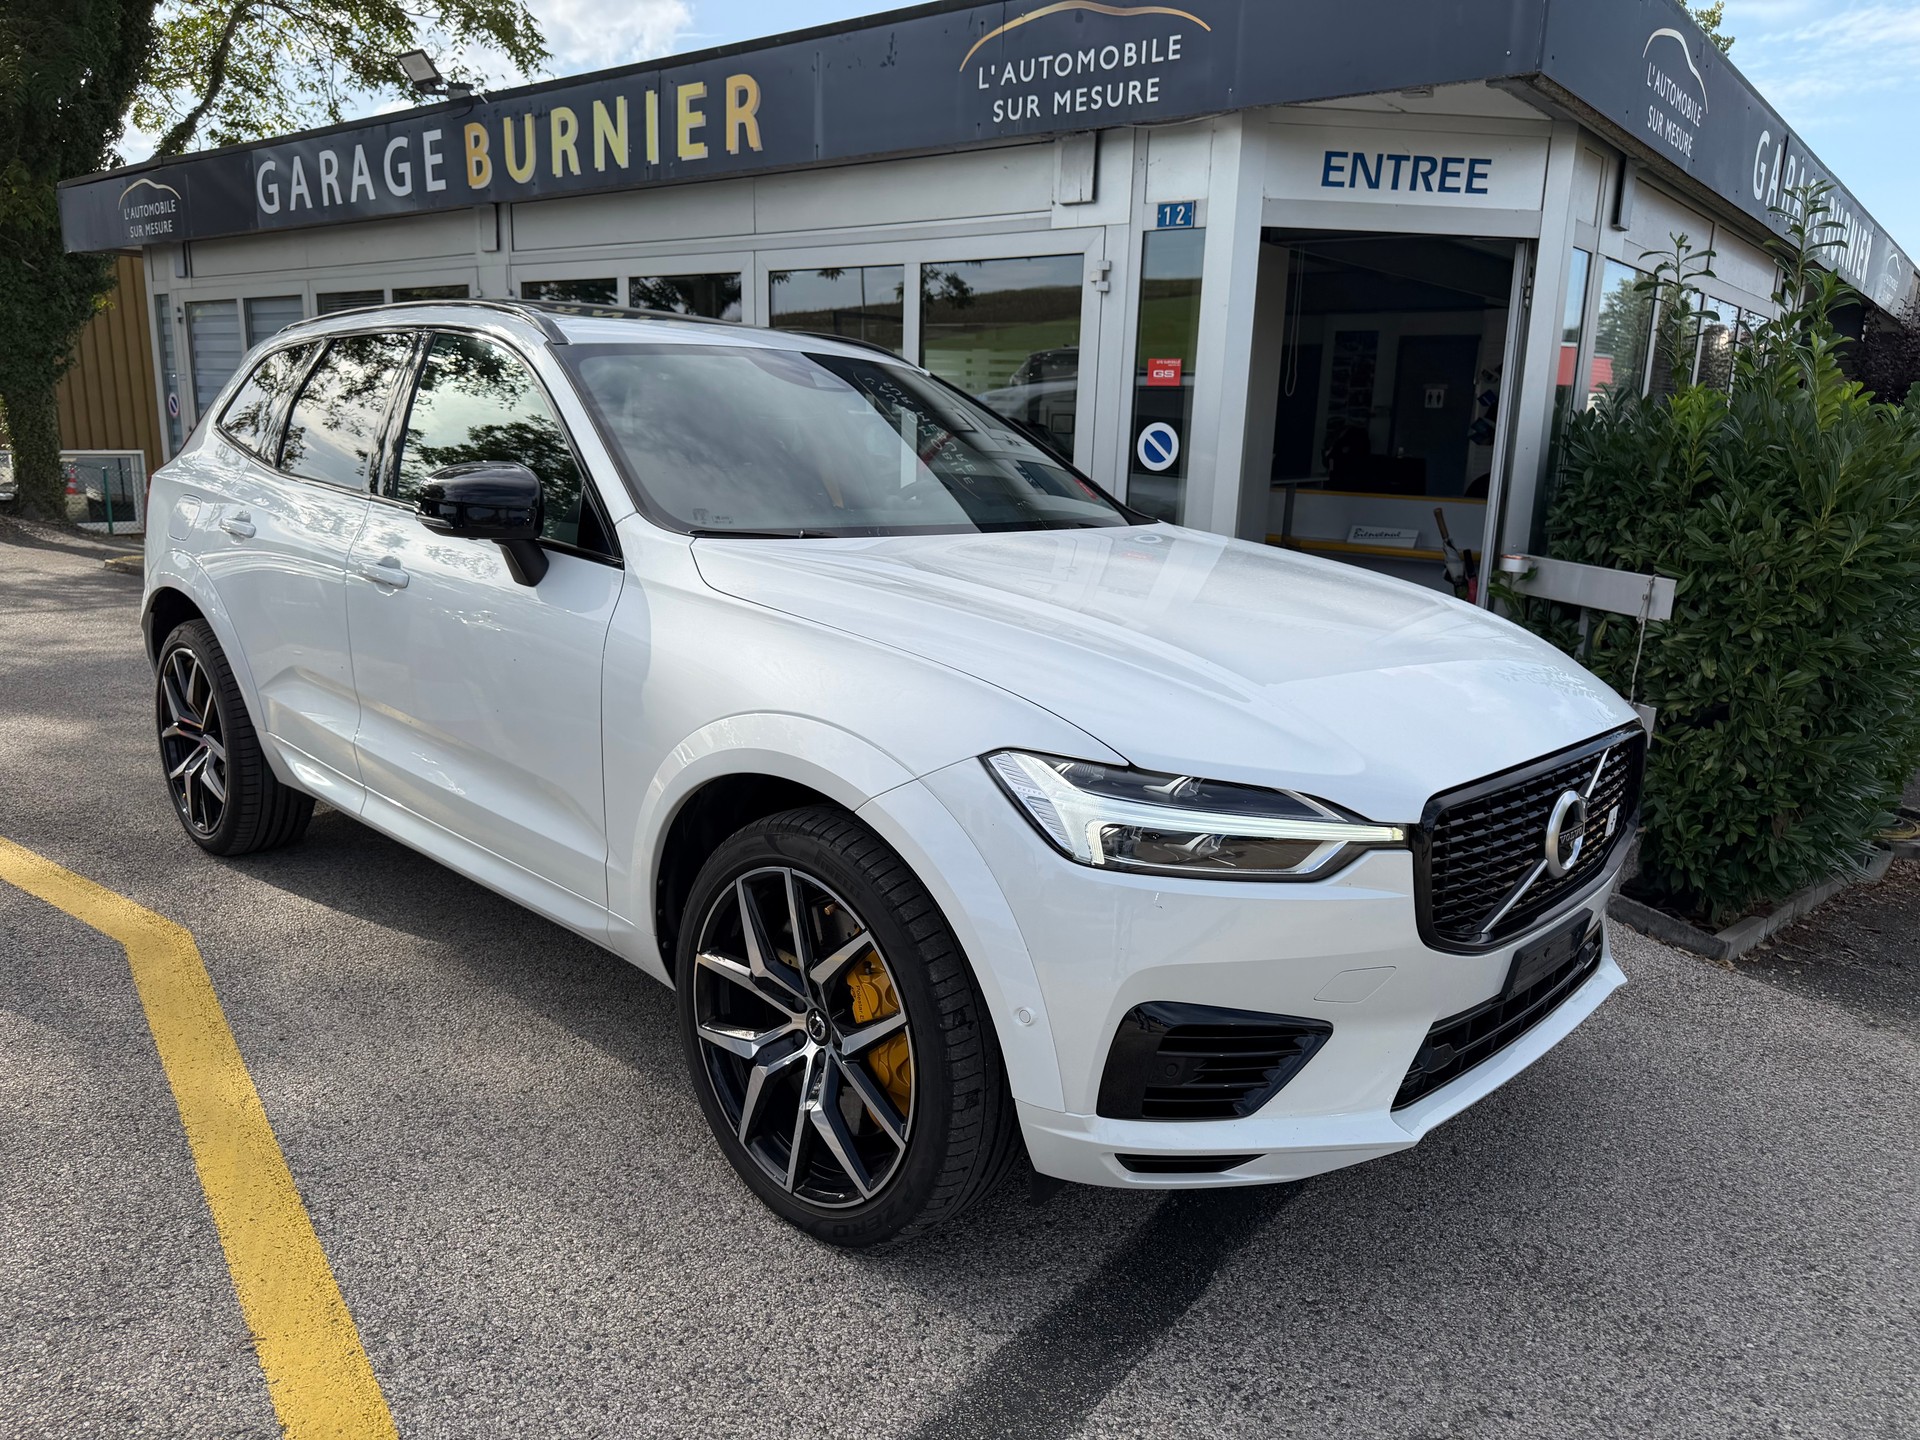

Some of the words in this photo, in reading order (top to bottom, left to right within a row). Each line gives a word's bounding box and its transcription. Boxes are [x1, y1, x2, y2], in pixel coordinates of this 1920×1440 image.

[978, 34, 1183, 90] L'AUTOMOBILE
[992, 94, 1041, 124] SUR
[1053, 77, 1160, 116] MESURE
[1646, 62, 1703, 128] L'AUTOMOBILE
[255, 128, 448, 215] GARAGE
[463, 73, 763, 190] BURNIER
[1647, 104, 1664, 141] SUR
[1665, 118, 1693, 159] MESURE
[1320, 150, 1493, 195] ENTREE
[124, 199, 176, 221] L'AUTOMOBILE
[130, 225, 144, 238] SUR
[145, 220, 173, 236] MESURE
[1163, 205, 1186, 227] 12
[1153, 369, 1175, 378] GS
[1559, 826, 1583, 844] VOLVO
